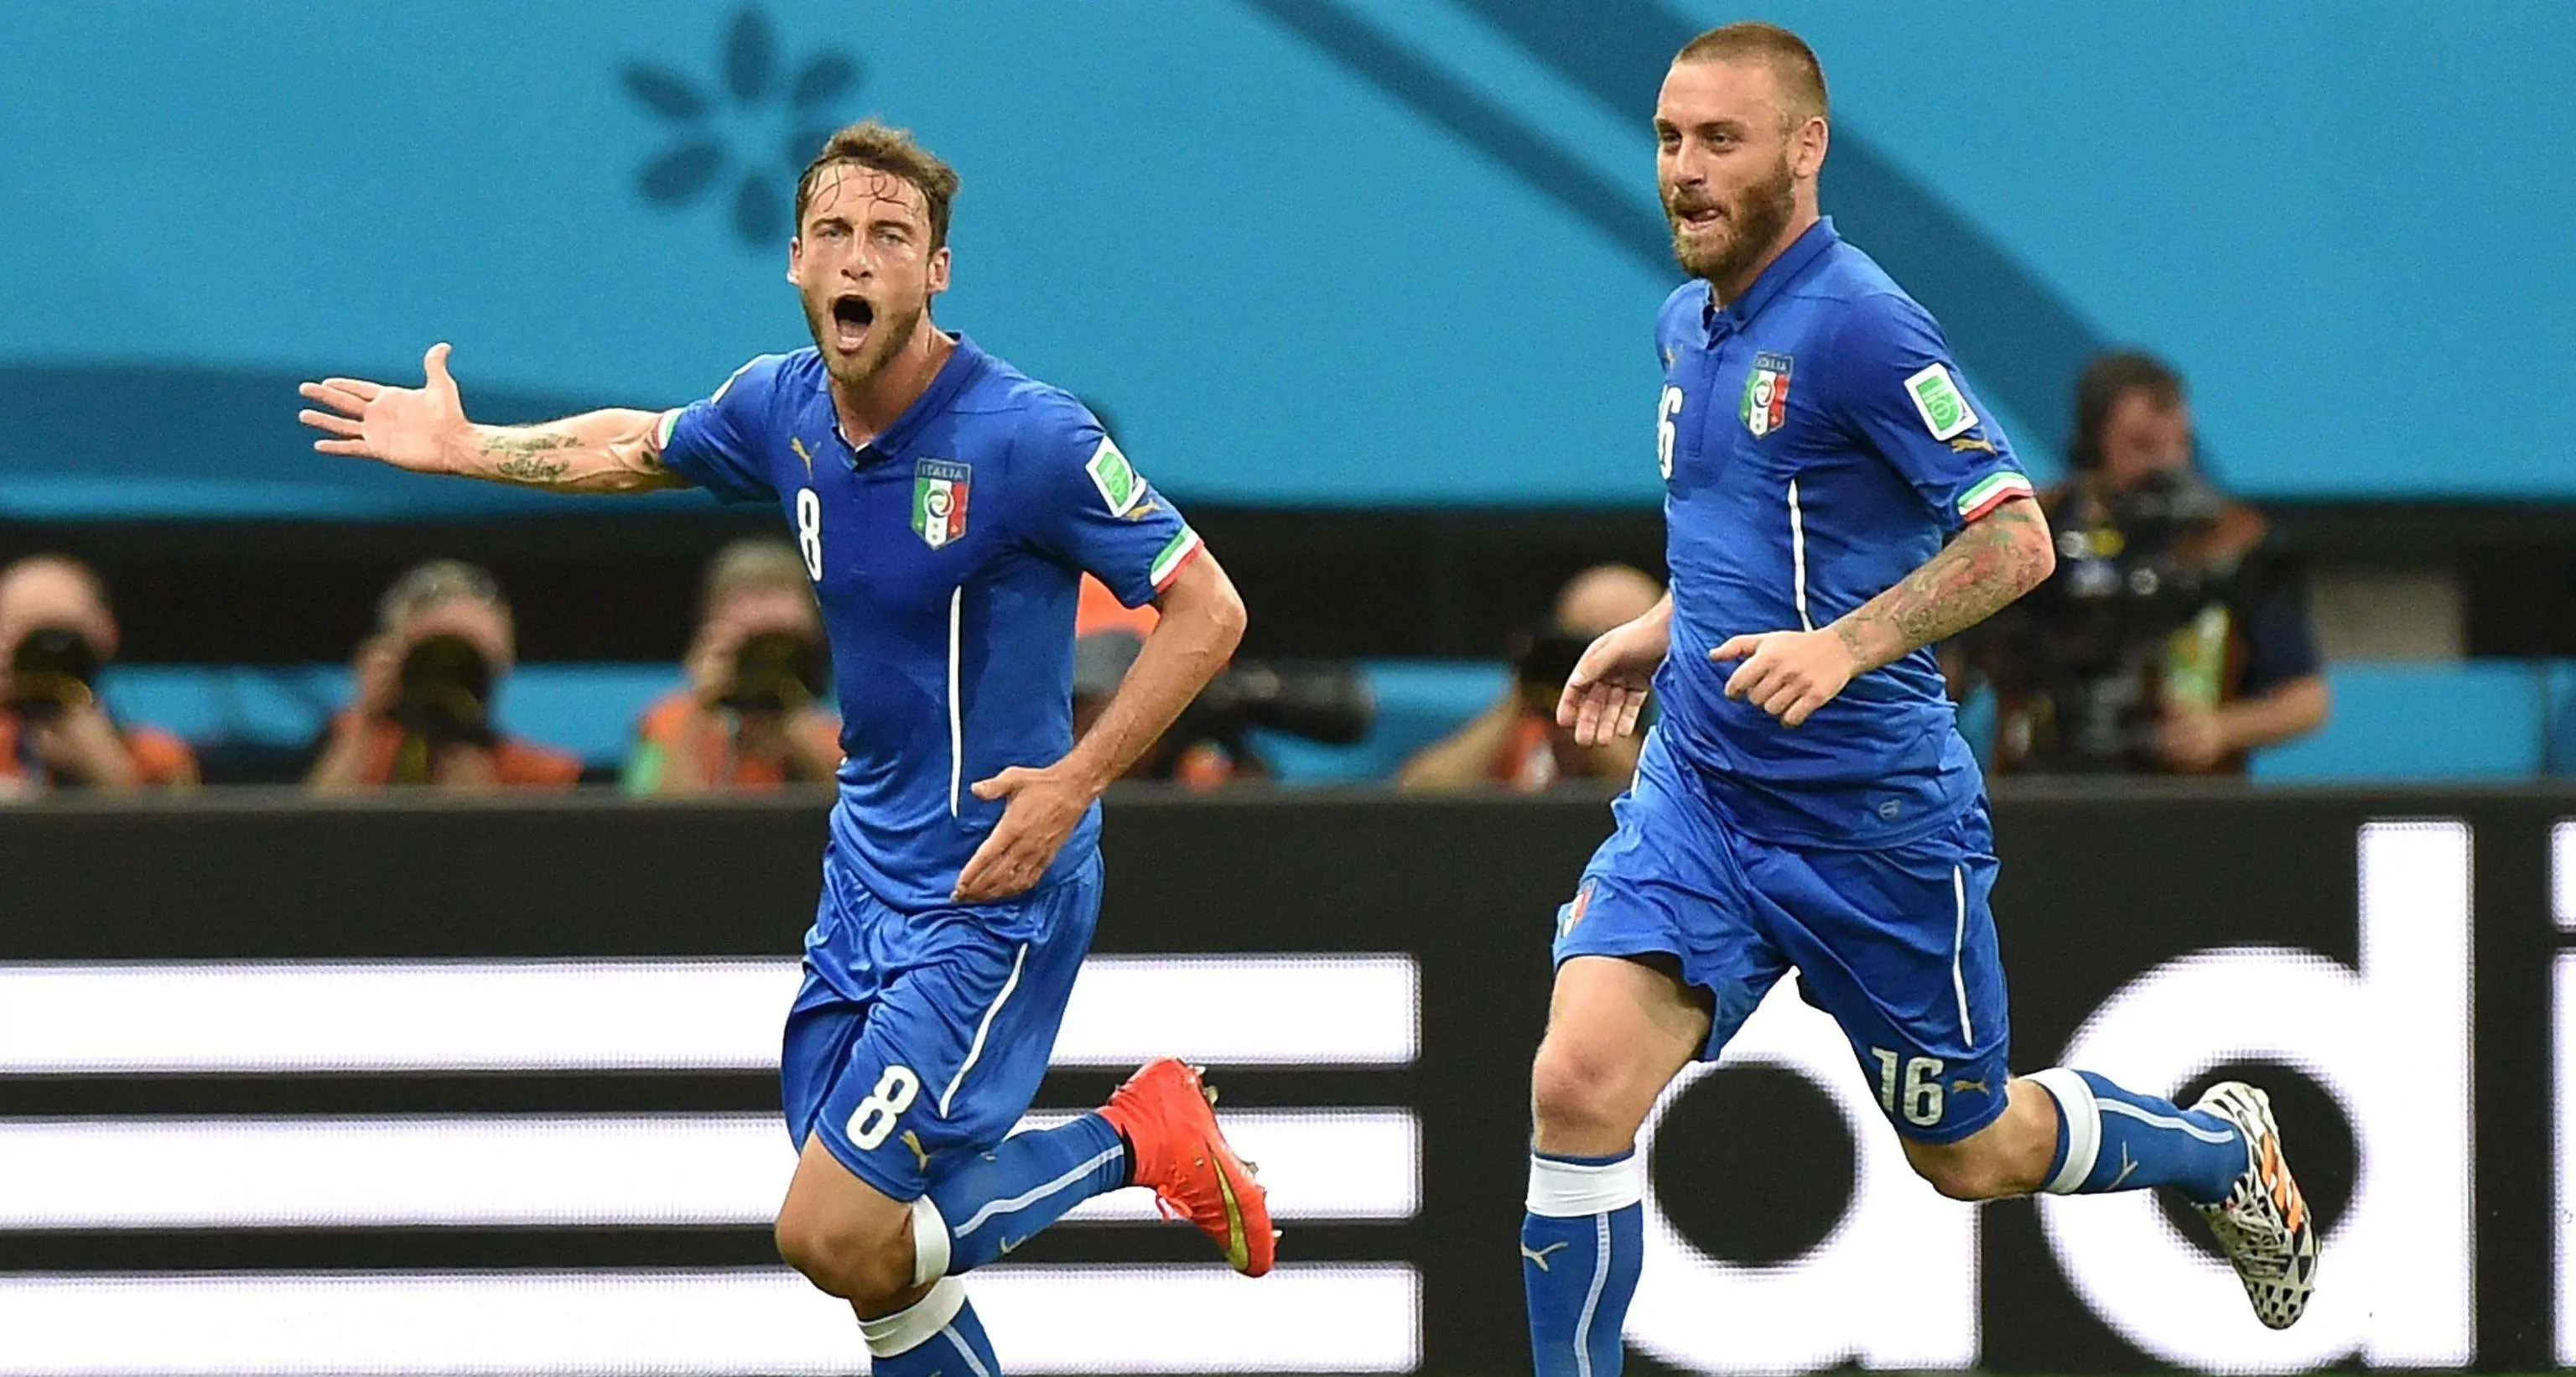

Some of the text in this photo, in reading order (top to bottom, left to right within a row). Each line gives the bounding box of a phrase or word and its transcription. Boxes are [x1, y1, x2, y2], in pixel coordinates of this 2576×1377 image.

[922, 464, 963, 479] ITALIA
[1657, 384, 1683, 480] 6
[797, 488, 822, 581] 8
[847, 1065, 919, 1150] 8
[1622, 819, 2576, 1377] ad
[1872, 1046, 1944, 1126] 16
